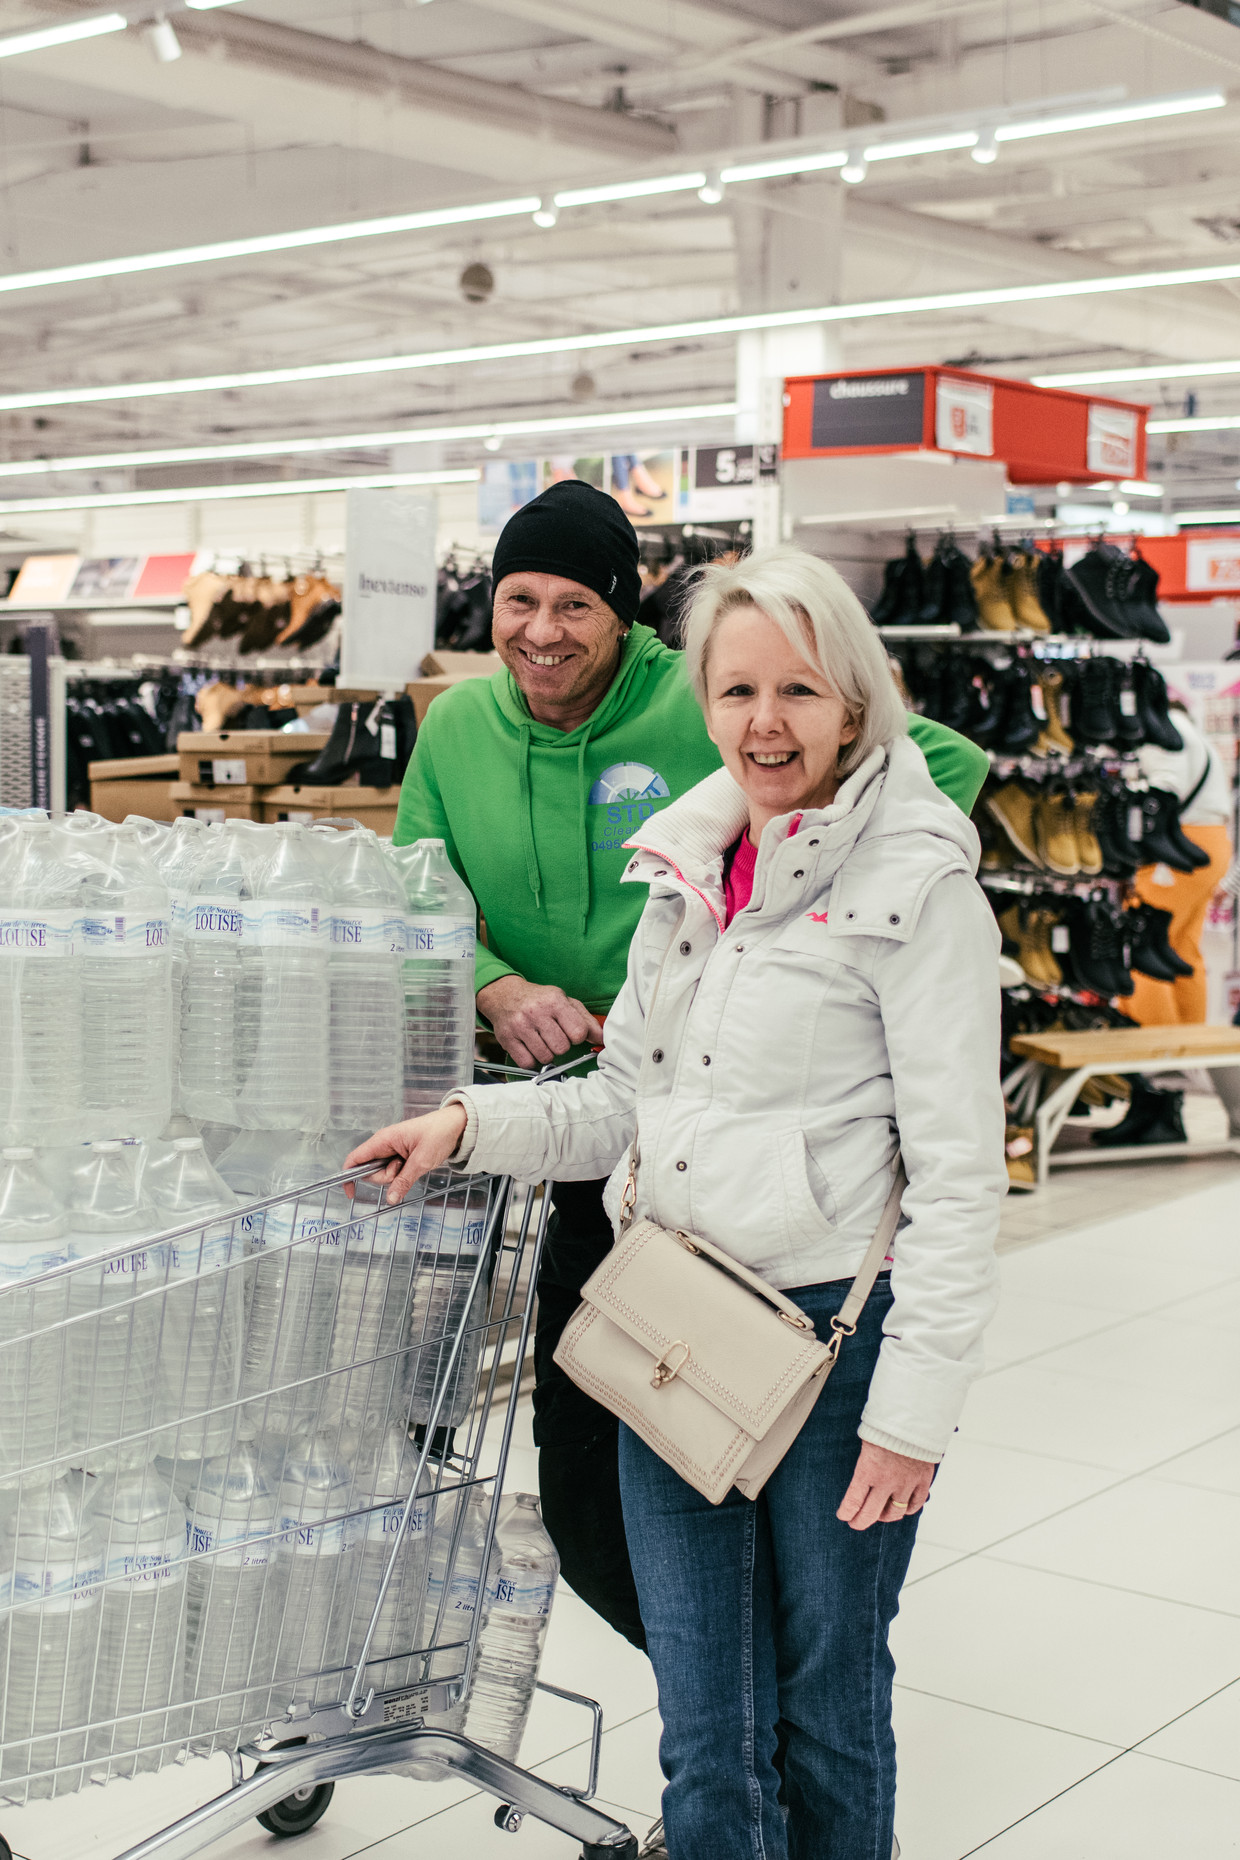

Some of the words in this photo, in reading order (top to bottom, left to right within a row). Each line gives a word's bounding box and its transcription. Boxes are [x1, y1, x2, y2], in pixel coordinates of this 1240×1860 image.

[829, 379, 909, 399] chaussure
[607, 803, 655, 824] STD
[195, 913, 238, 932] LOUISE
[0, 928, 46, 947] LOUISE
[146, 928, 169, 947] LOU
[332, 926, 362, 943] UISE
[406, 934, 434, 950] UISE
[244, 1557, 250, 1565] 2
[500, 1578, 518, 1586] ource
[496, 1583, 516, 1603] ISE
[455, 1601, 462, 1609] 2
